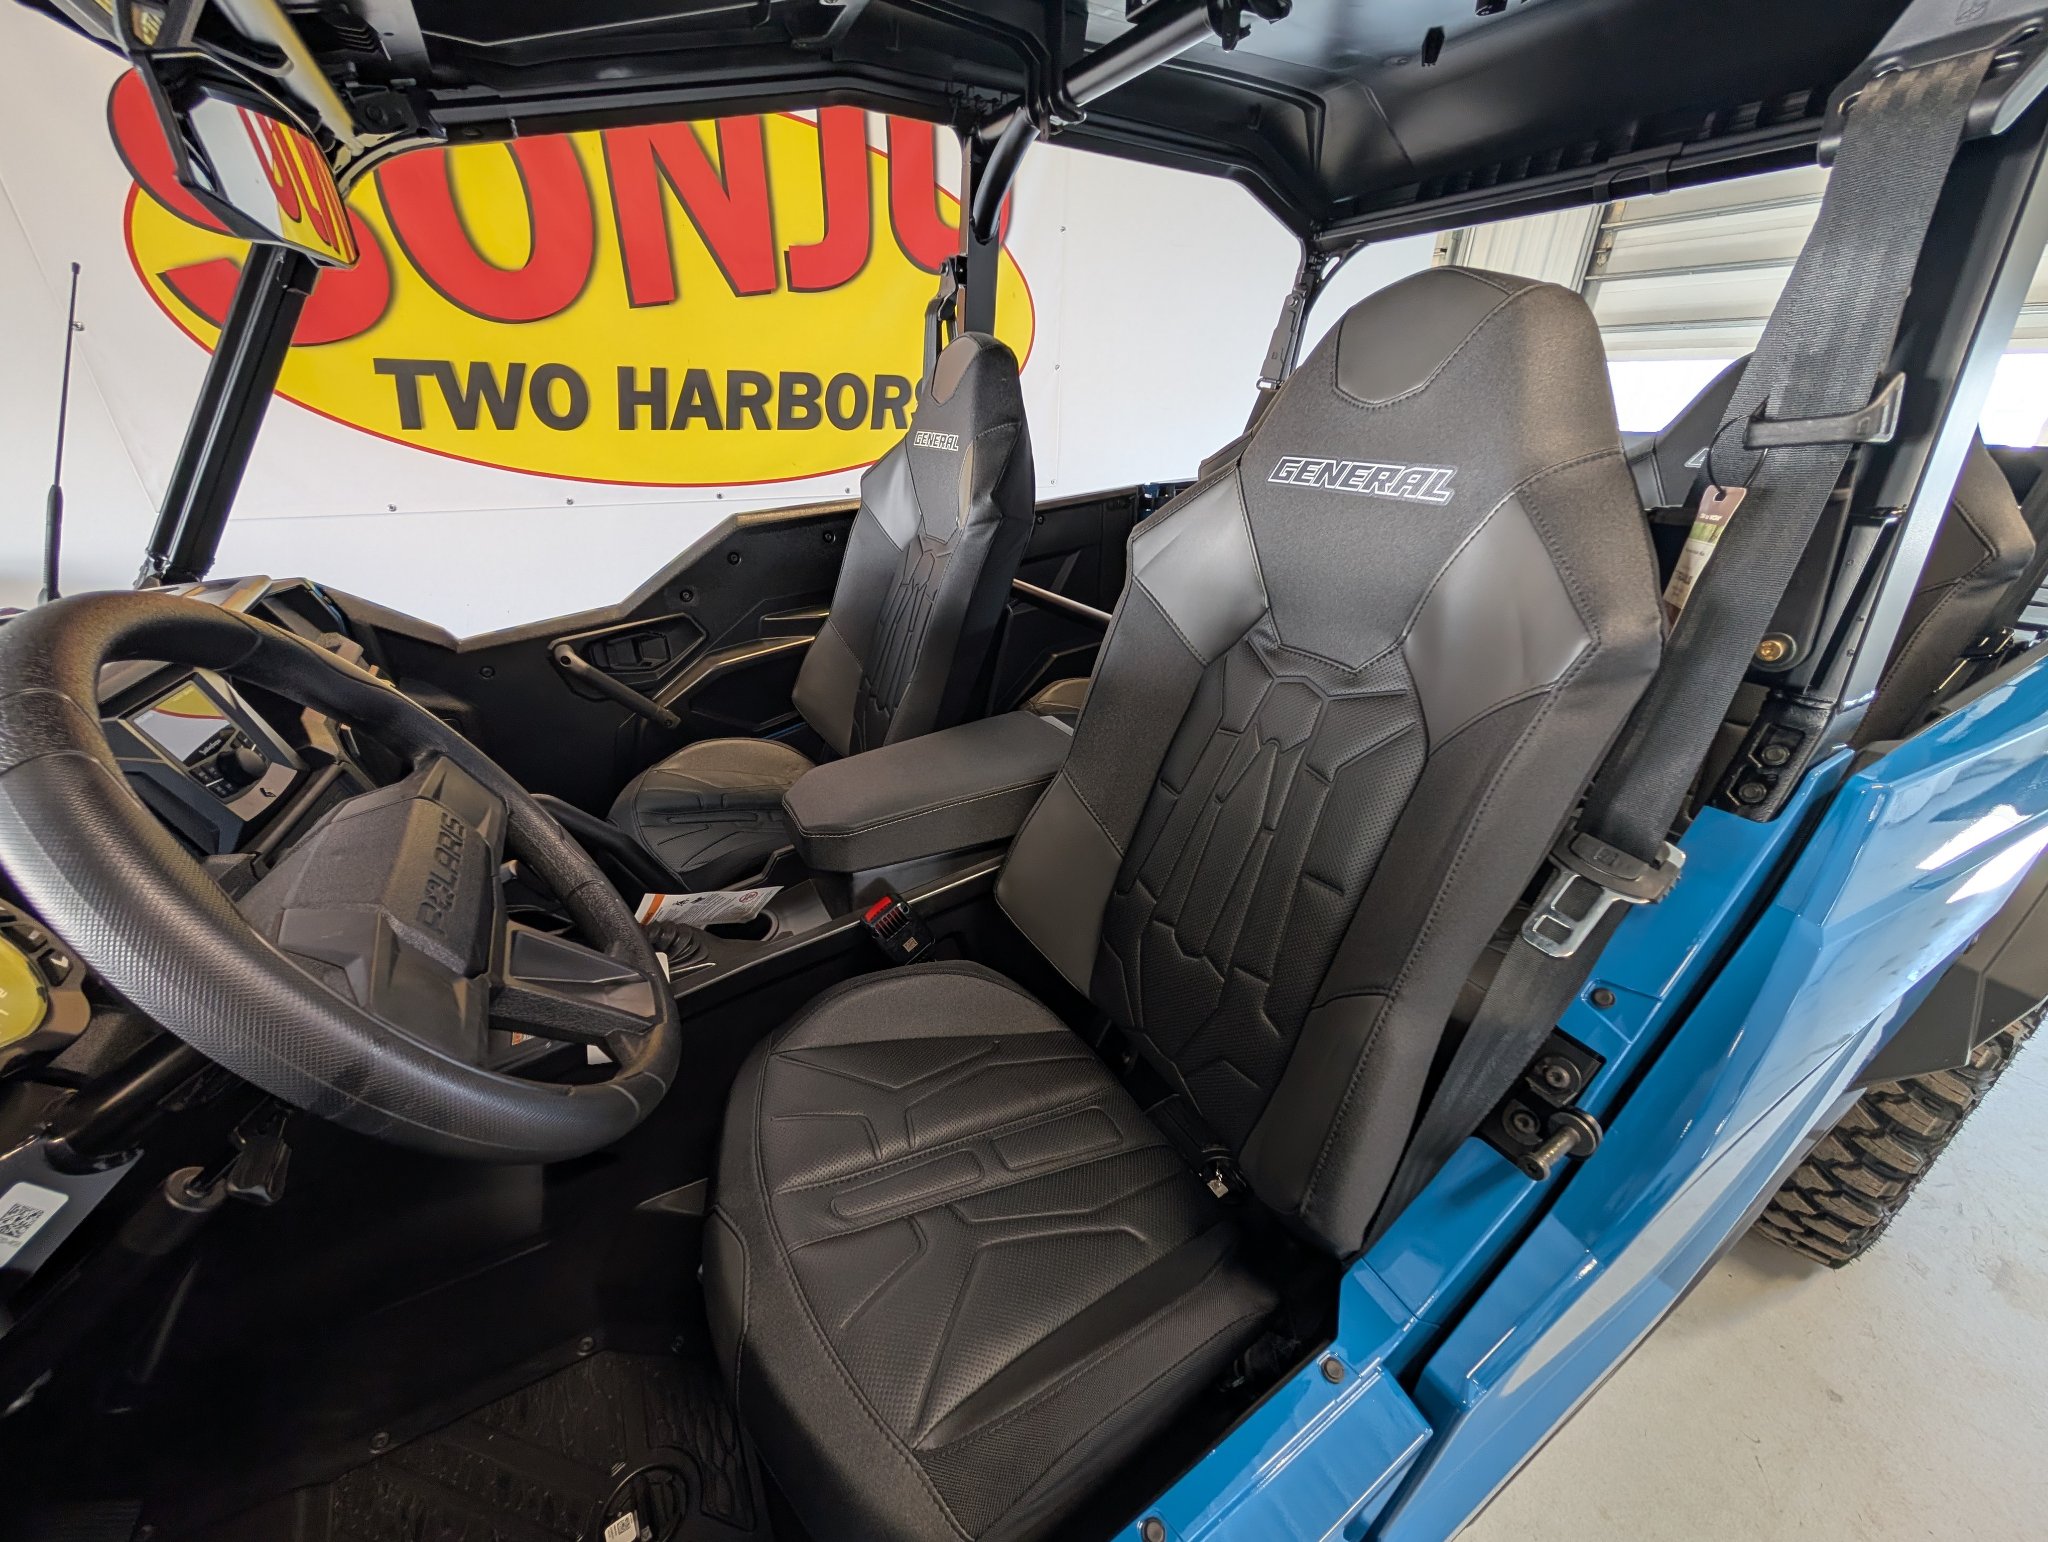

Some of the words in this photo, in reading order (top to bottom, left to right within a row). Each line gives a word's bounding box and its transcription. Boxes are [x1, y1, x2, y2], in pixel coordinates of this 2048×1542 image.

[373, 358, 590, 431] TWO
[617, 365, 922, 431] HARBOR
[914, 431, 959, 451] GENERAL
[1268, 456, 1454, 502] GENERAL
